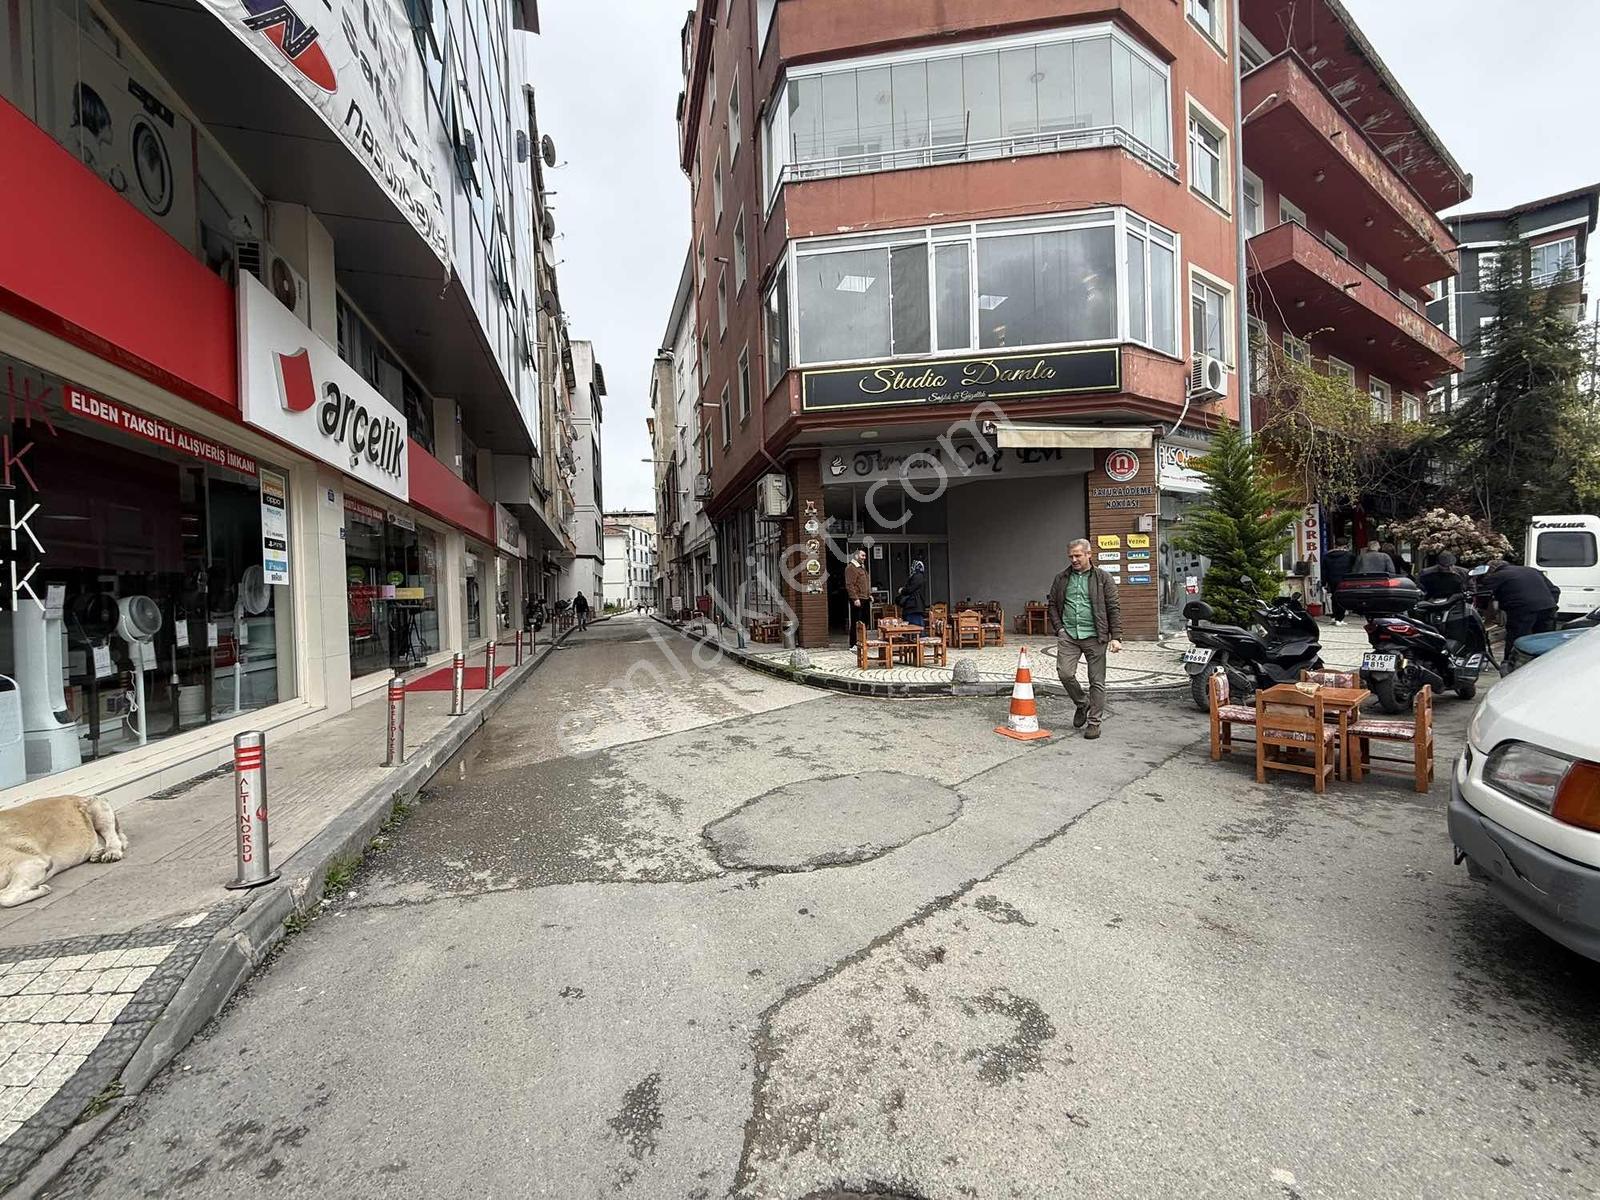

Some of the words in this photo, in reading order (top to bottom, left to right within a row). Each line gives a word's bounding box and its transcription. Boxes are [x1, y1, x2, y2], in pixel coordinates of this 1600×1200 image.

[858, 367, 948, 394] Studio
[961, 359, 1056, 386] Damla
[71, 391, 119, 424] ELDEN
[121, 410, 176, 445] TAKSİTLİ
[177, 433, 226, 466] ALIŞVERİŞ
[227, 449, 256, 474] İMKANI
[319, 380, 405, 478] arçelik
[239, 777, 253, 863] ALTINORDU
